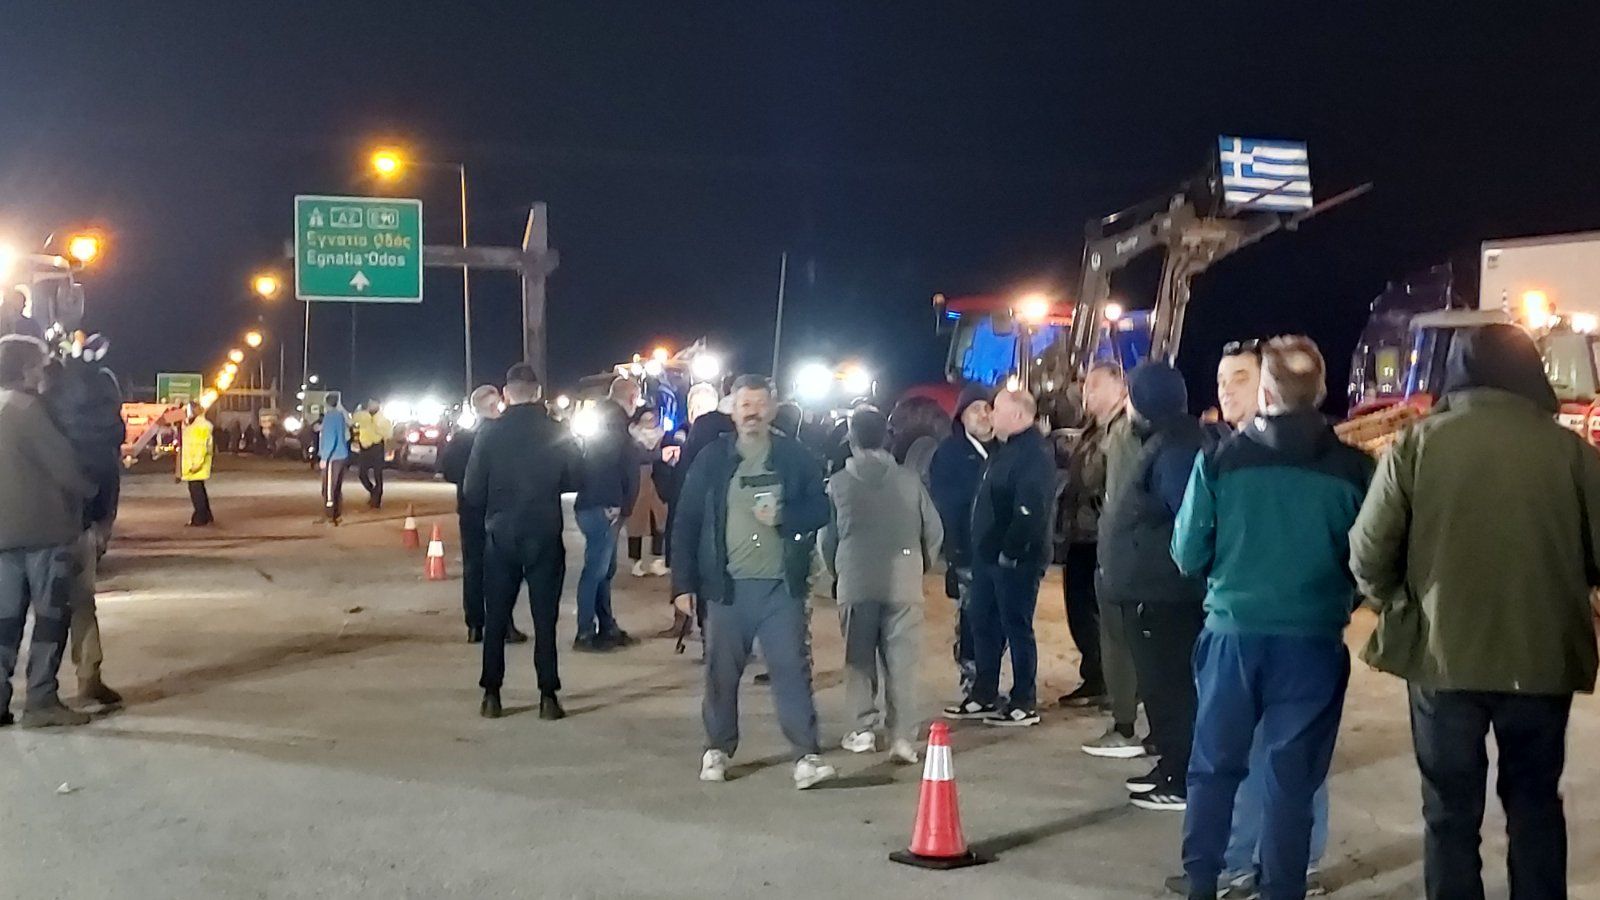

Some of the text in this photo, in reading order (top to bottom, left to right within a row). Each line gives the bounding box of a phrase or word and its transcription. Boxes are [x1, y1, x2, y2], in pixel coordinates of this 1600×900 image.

[337, 211, 357, 225] A2
[307, 249, 406, 268] Egnatia Odos
